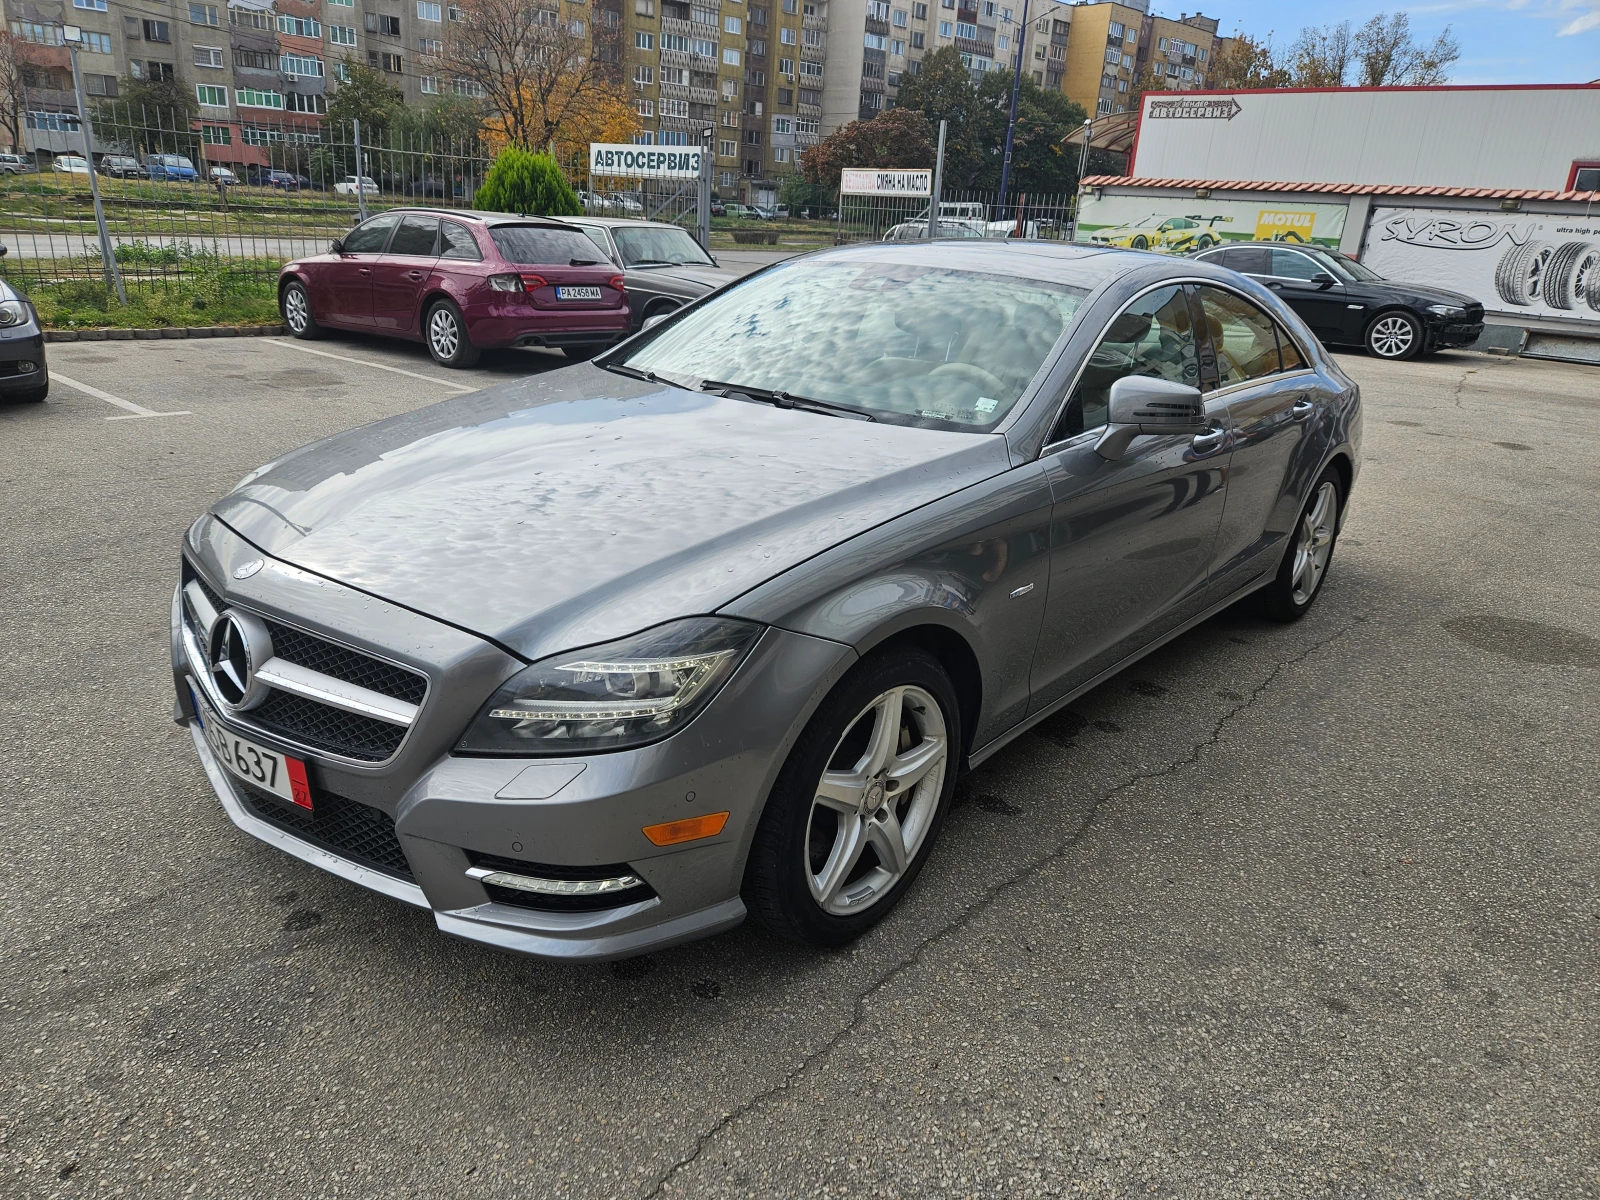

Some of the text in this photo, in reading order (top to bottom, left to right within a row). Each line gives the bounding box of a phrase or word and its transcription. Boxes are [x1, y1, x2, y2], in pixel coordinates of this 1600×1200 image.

[1152, 107, 1229, 118] АВТОСЕРВИЗ
[595, 150, 700, 171] АВТОСЕРВИЗ
[877, 174, 895, 190] СМЯНА
[898, 174, 905, 191] НА
[907, 174, 928, 191] МАСЛО
[1260, 213, 1311, 226] MOTUL
[1381, 218, 1536, 250] SYRON
